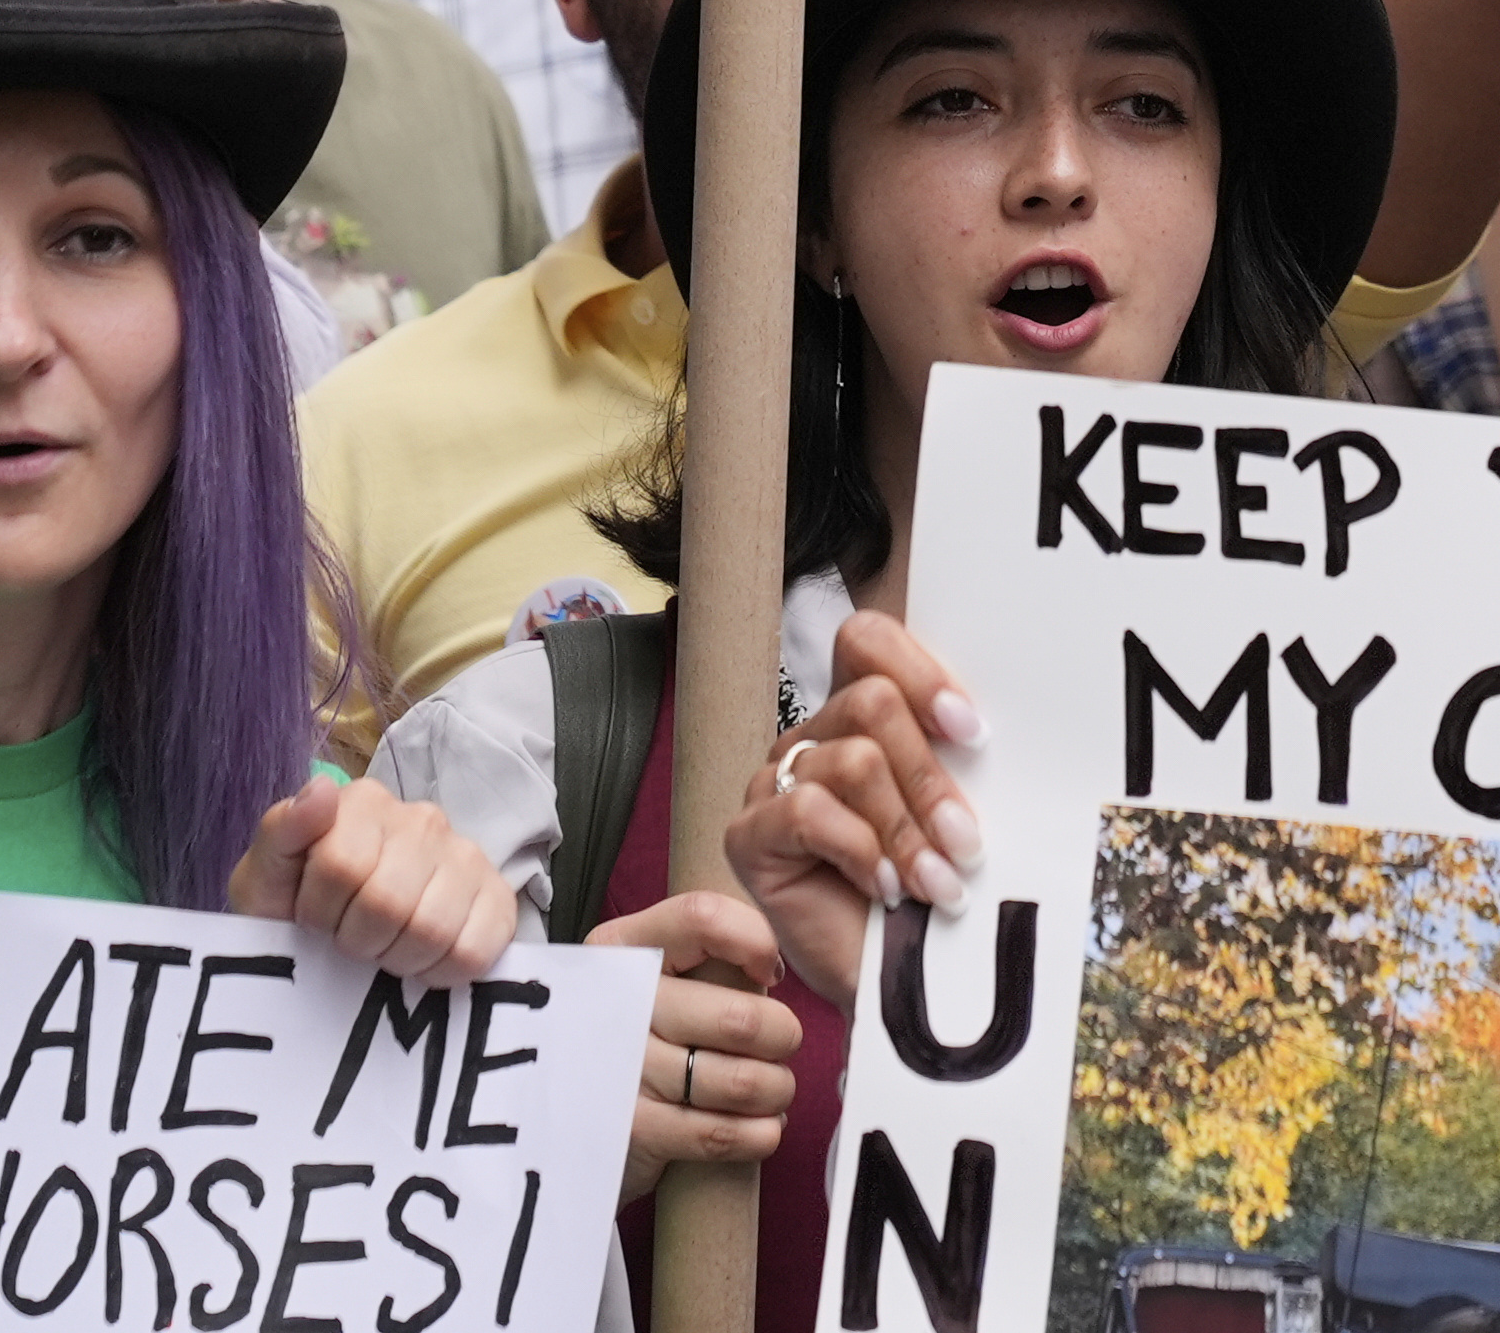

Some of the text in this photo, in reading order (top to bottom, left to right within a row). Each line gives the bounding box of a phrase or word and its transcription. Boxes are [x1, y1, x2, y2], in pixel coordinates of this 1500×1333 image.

[1036, 402, 1403, 578] KEEP
[1122, 627, 1398, 805] MY
[313, 971, 551, 1150] ME
